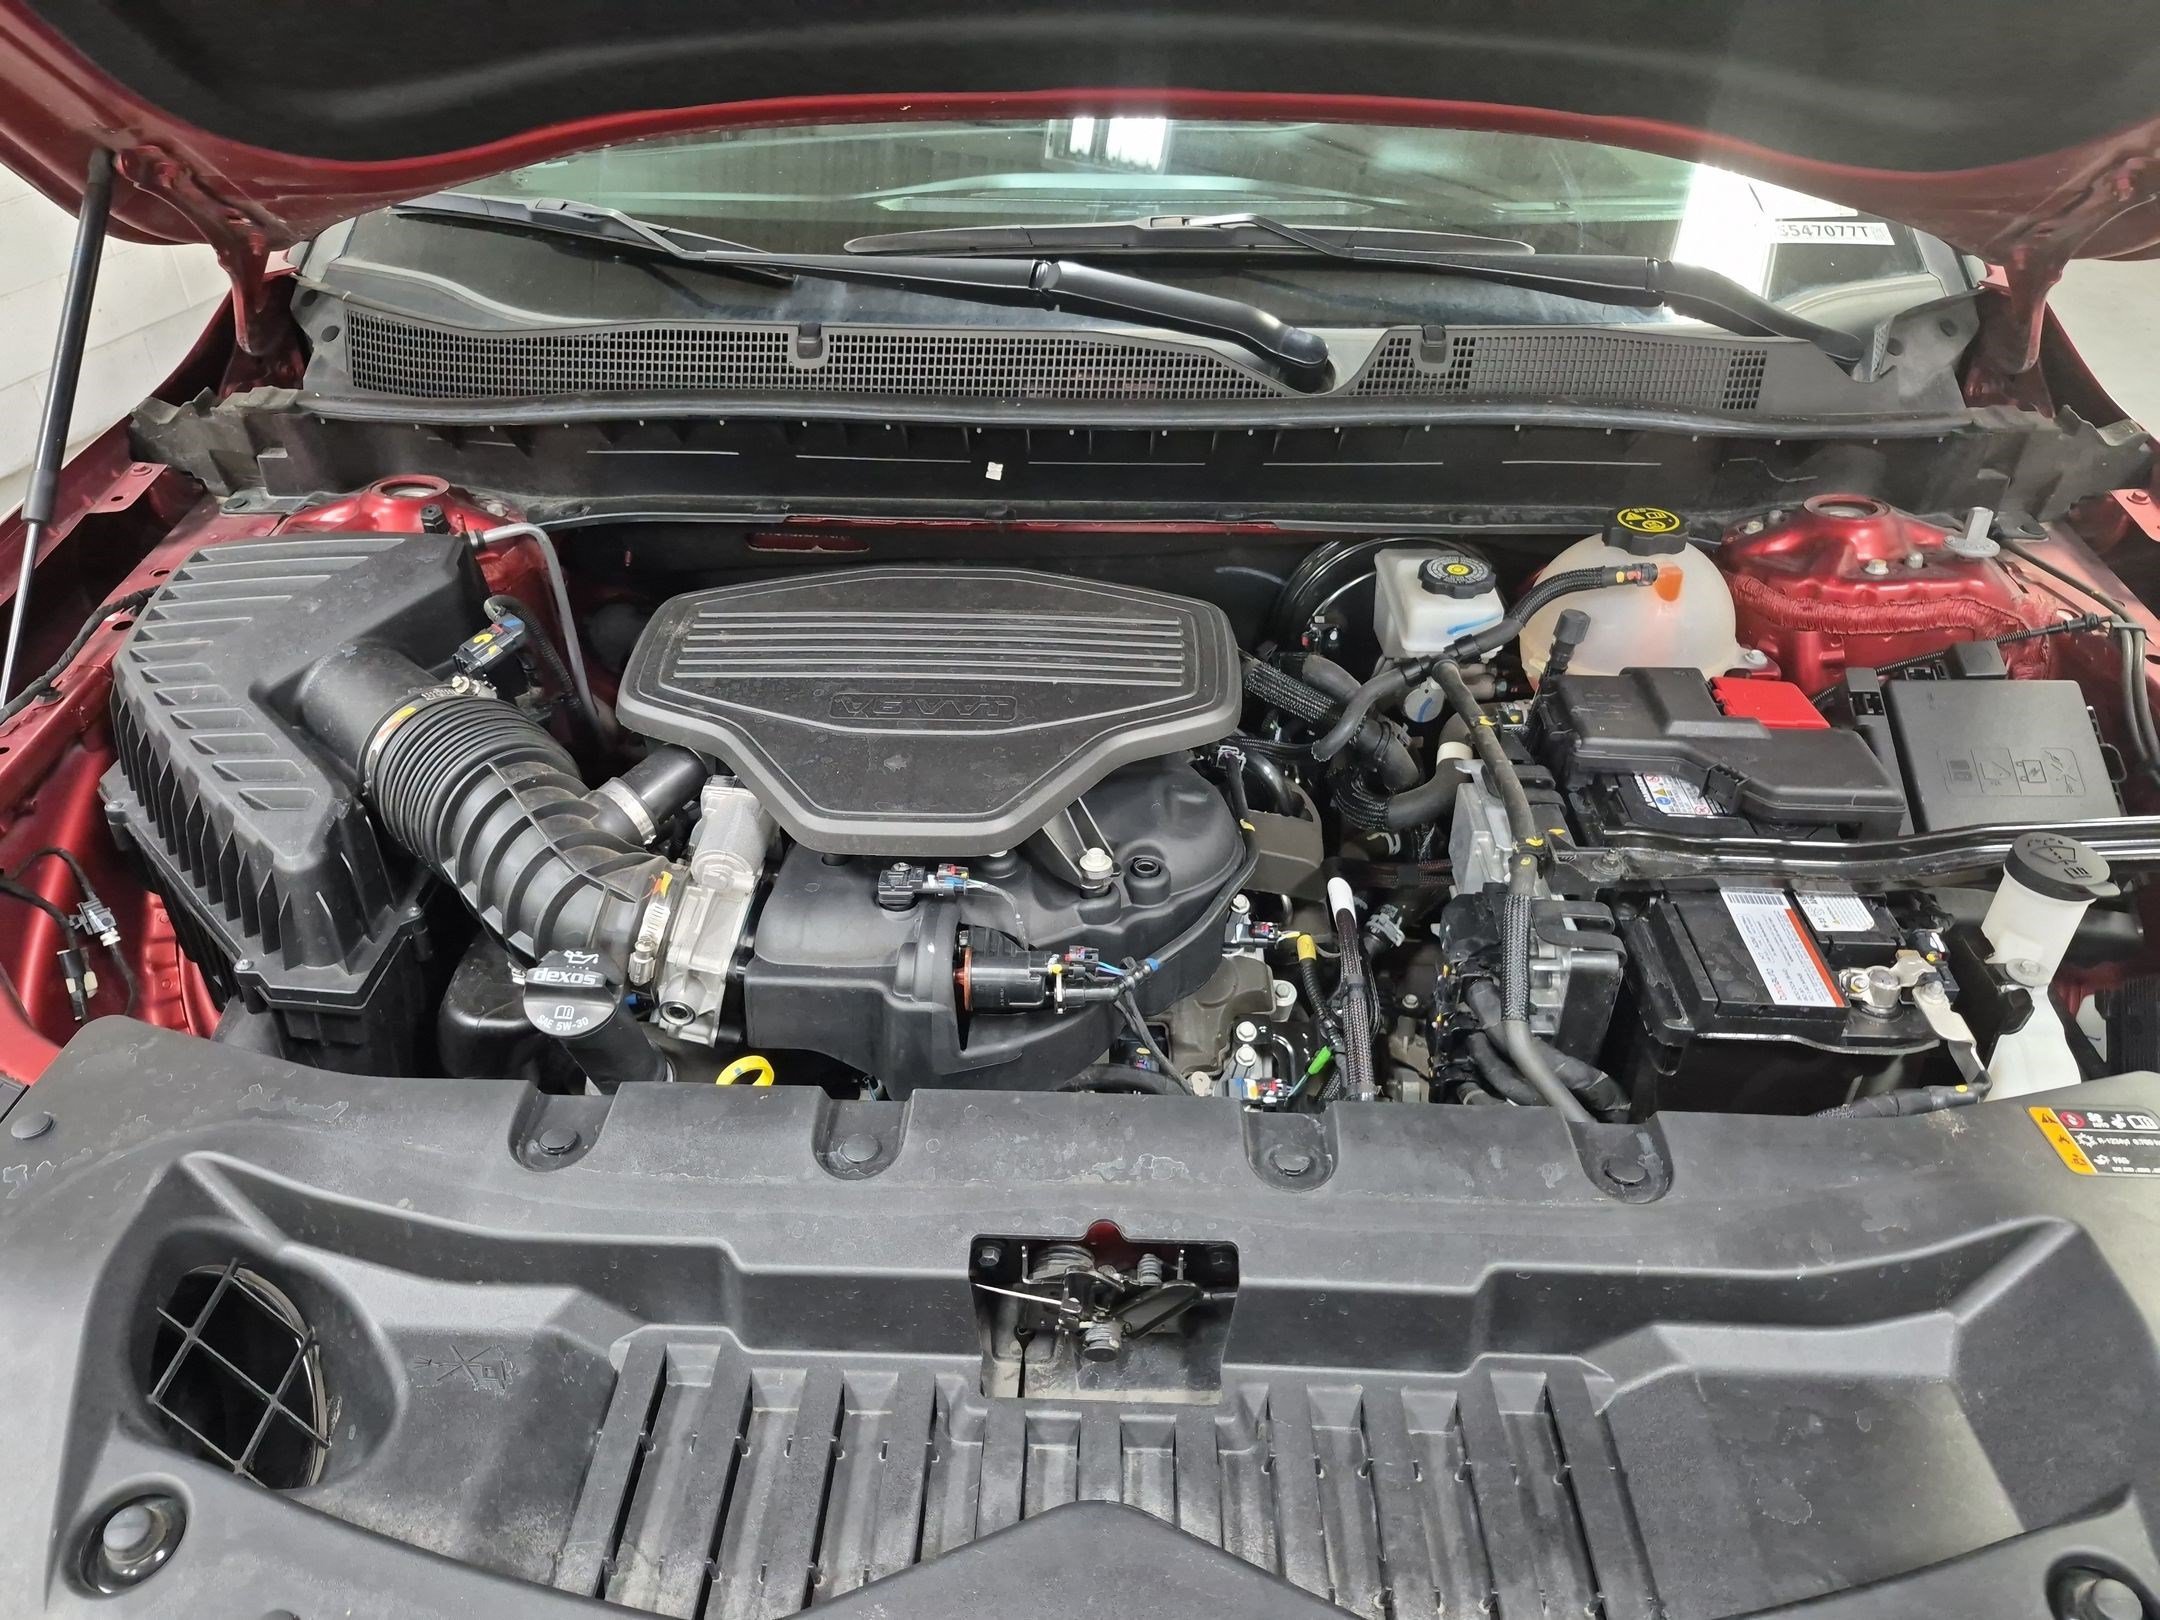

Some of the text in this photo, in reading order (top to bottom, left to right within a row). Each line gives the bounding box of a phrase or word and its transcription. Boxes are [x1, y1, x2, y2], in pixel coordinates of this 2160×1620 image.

[533, 967, 599, 985] dexos
[536, 1014, 589, 1031] SAE 5W-30
